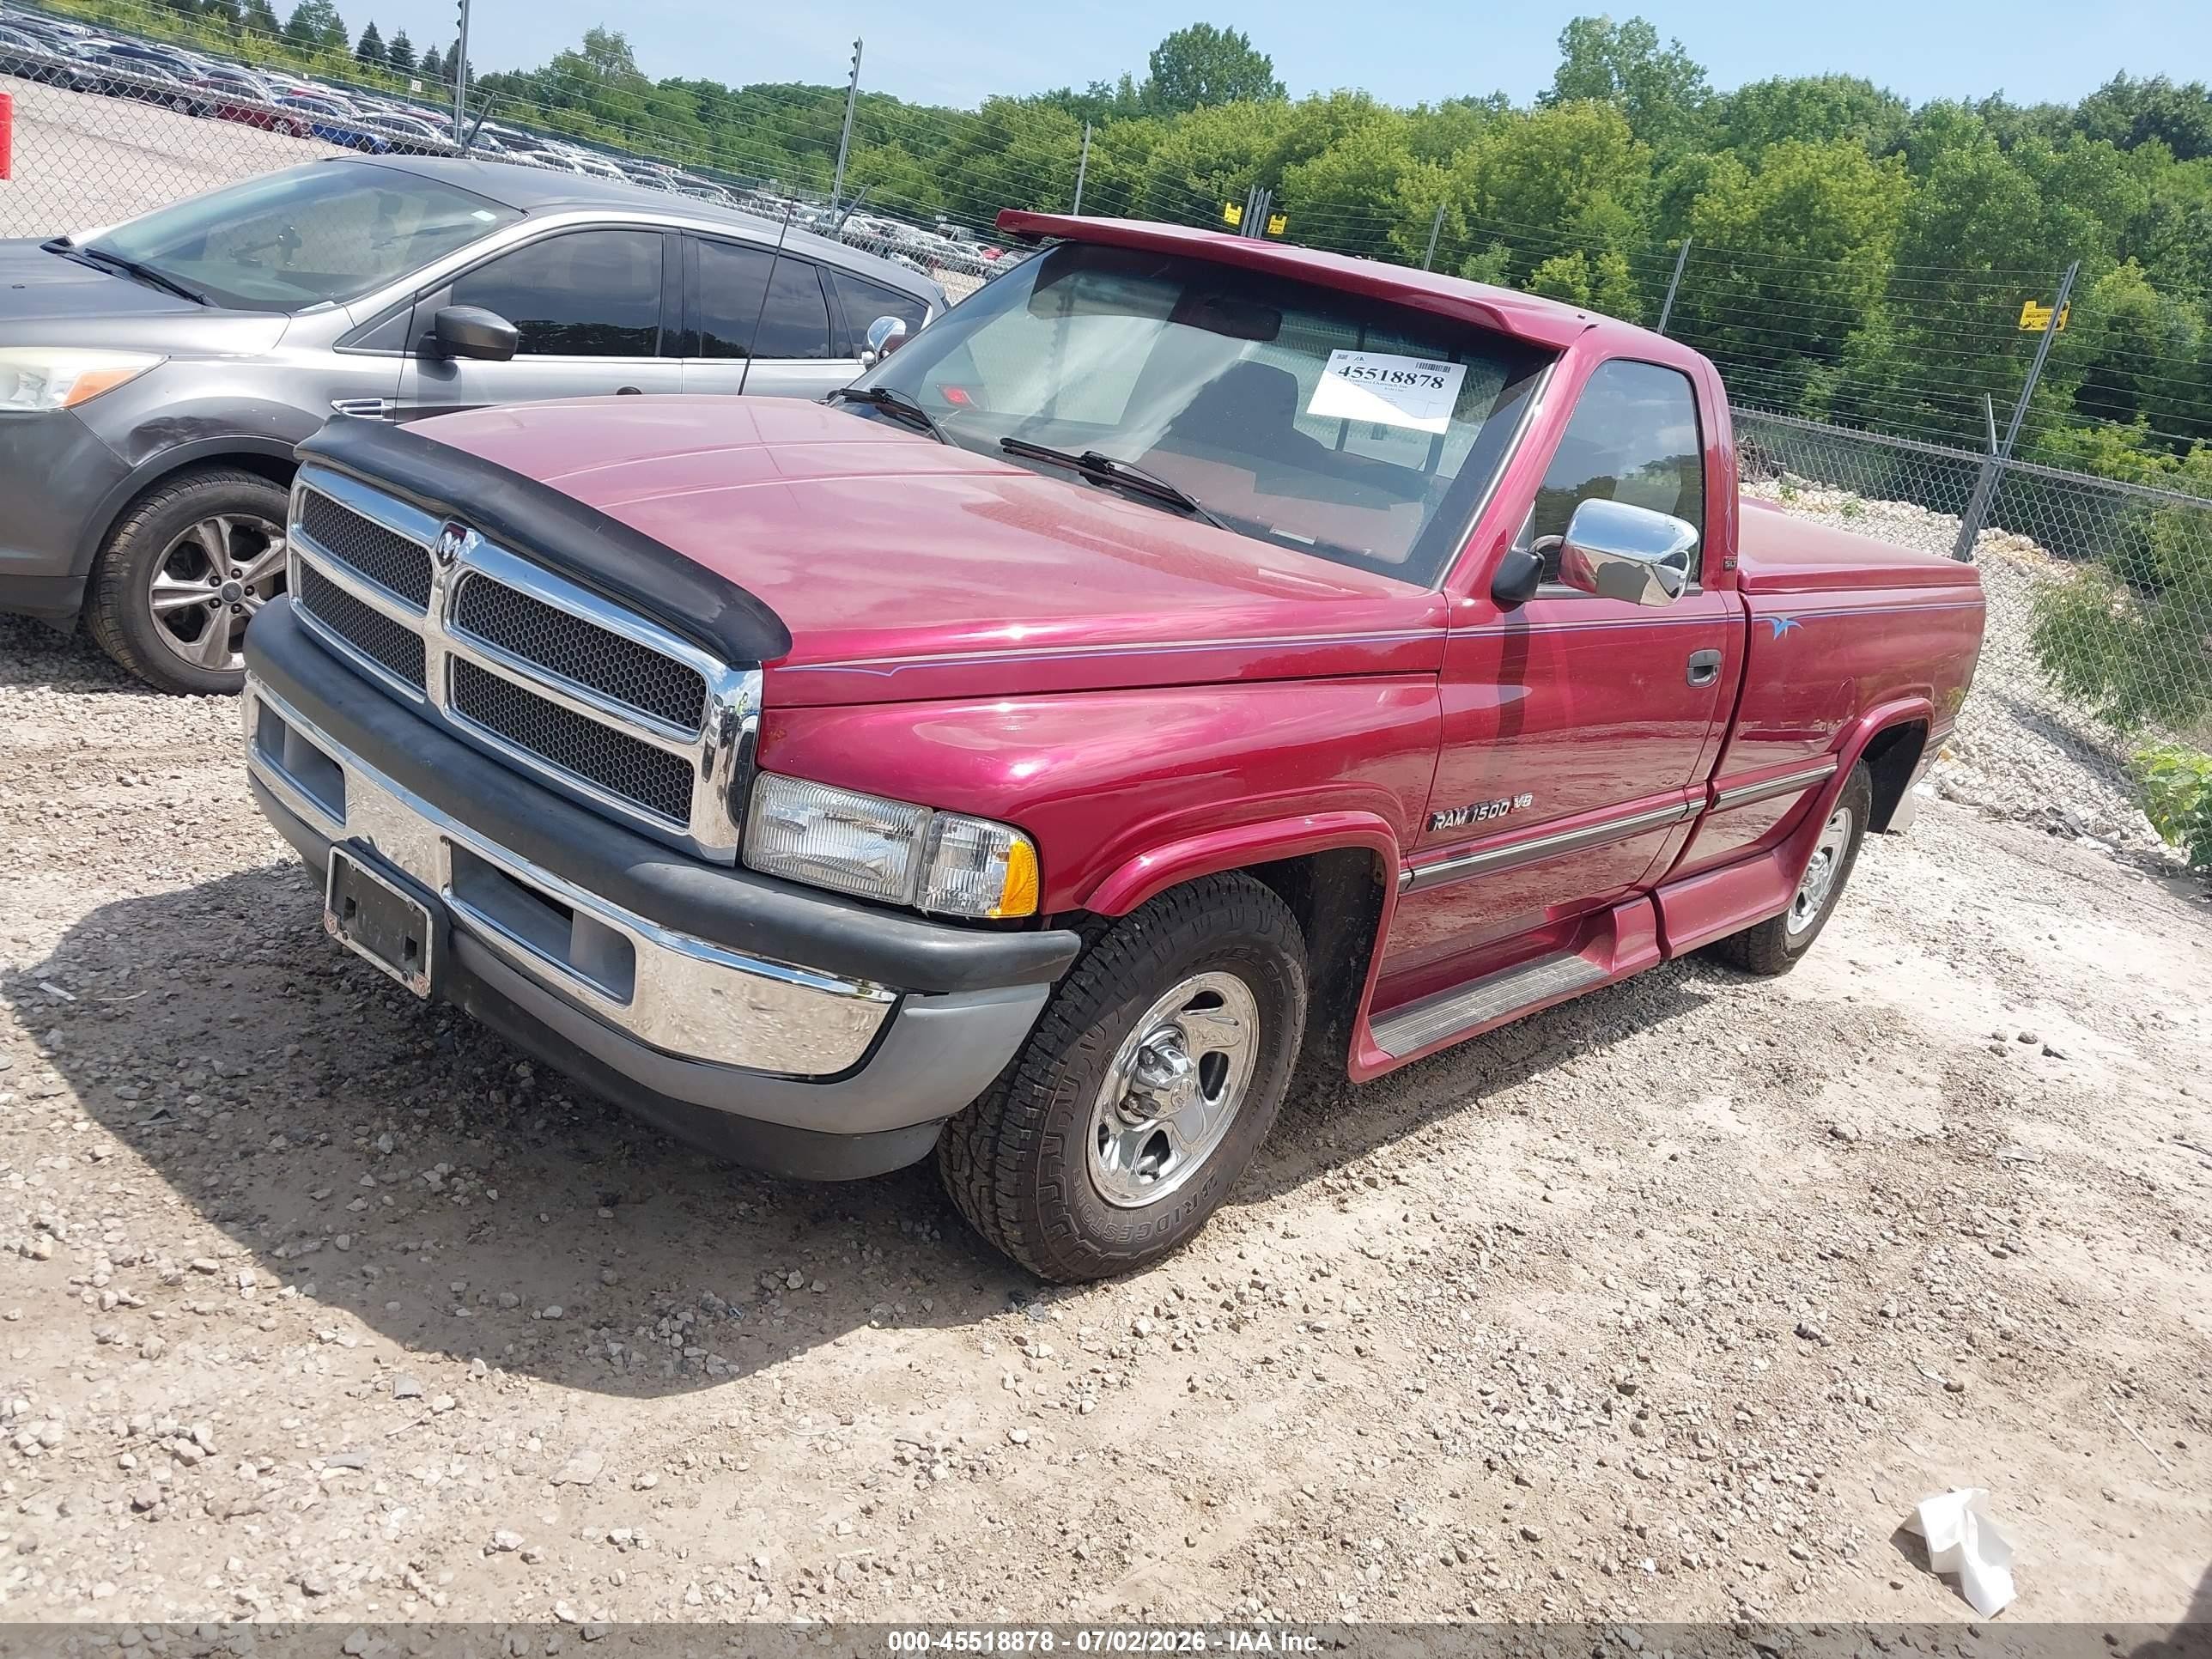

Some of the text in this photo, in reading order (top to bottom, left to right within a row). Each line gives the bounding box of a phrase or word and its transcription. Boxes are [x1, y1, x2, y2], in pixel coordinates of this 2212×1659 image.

[1338, 365, 1444, 390] 45518878
[1429, 808, 1469, 832] RAM
[1470, 799, 1511, 823] 1500
[1072, 1168, 1218, 1243] BRIDGESTONE
